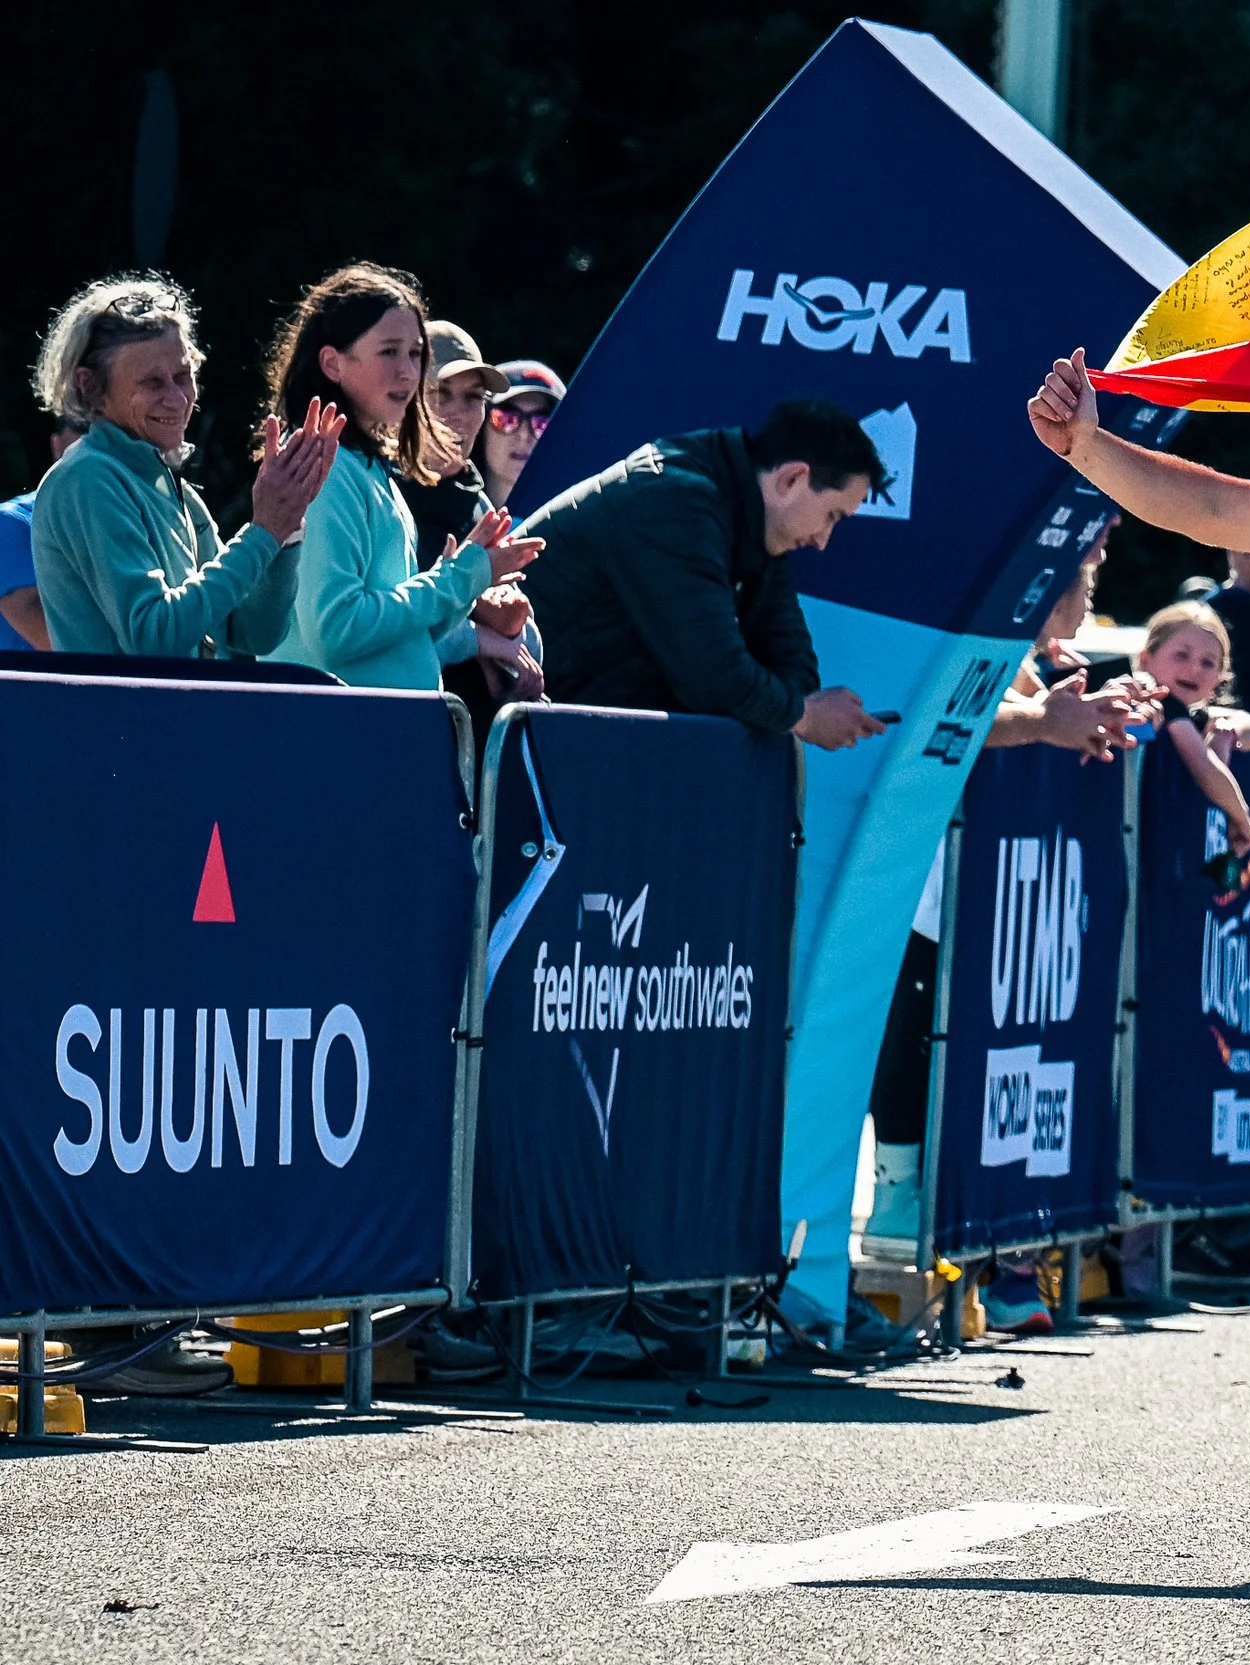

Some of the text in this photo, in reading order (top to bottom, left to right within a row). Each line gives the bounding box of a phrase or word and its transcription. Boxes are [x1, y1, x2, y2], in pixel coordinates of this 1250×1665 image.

[717, 268, 972, 363] HOKA
[1239, 312, 1250, 320] de
[992, 826, 1083, 1031] UTMB
[634, 941, 695, 1032] south
[697, 941, 753, 1030] wales
[53, 1003, 370, 1176] SUUNTO
[988, 1071, 1031, 1140] WORLD
